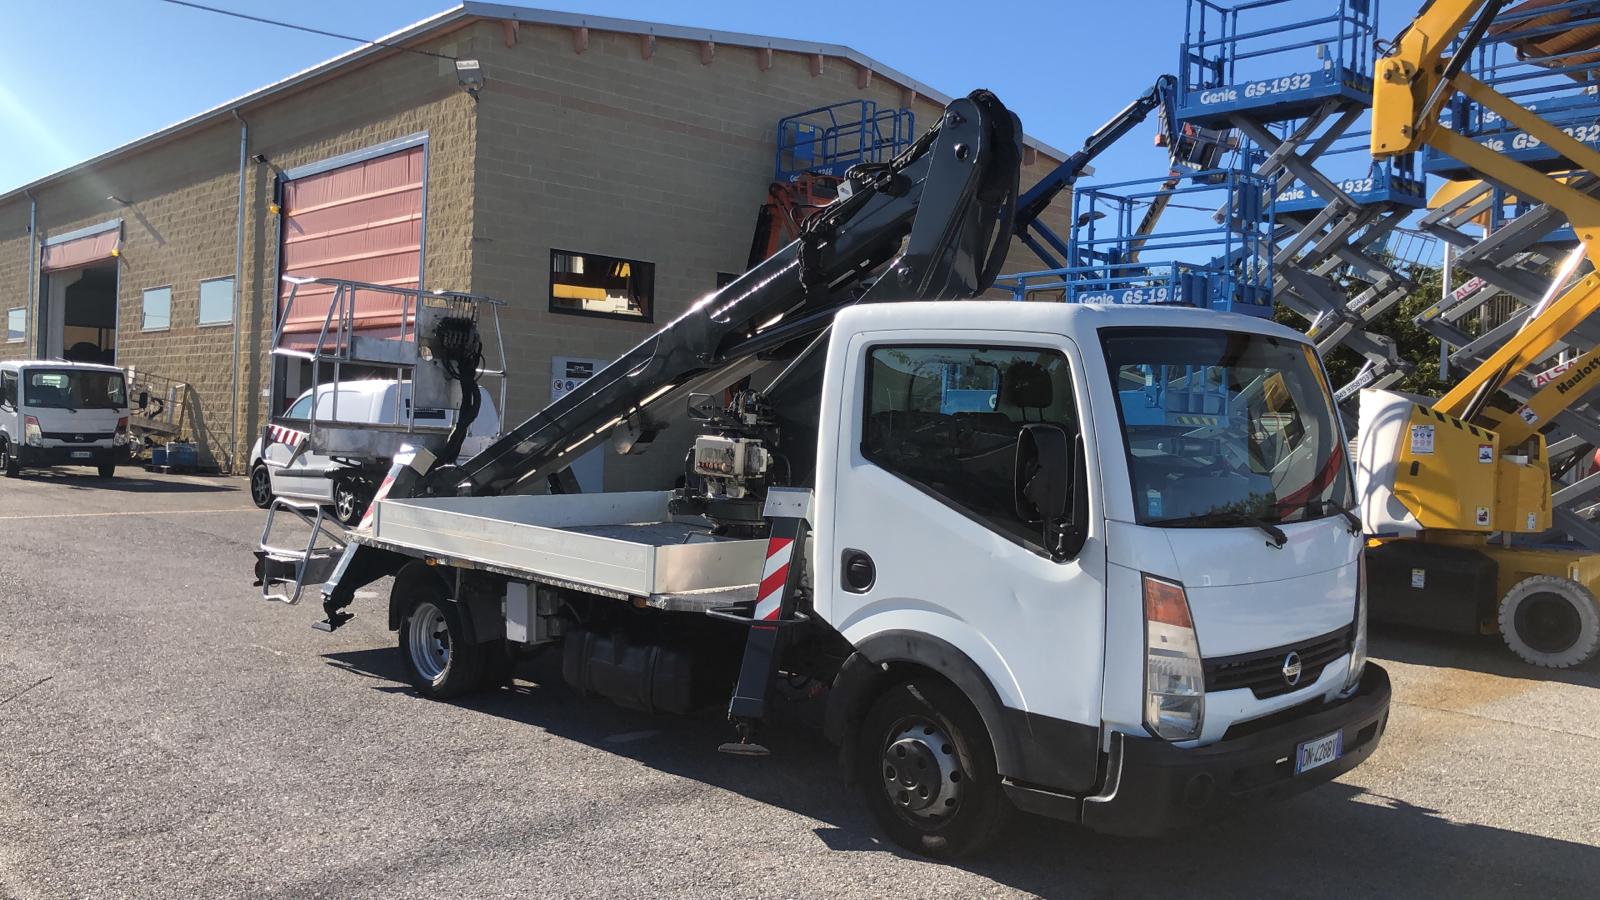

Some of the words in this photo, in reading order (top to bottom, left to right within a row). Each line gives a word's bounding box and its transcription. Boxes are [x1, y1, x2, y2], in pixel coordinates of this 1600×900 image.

[1200, 88, 1237, 105] Genie
[1244, 73, 1312, 98] GS-1932
[1275, 189, 1305, 202] enie
[1078, 292, 1115, 305] Genie
[1122, 287, 1182, 304] GS-19
